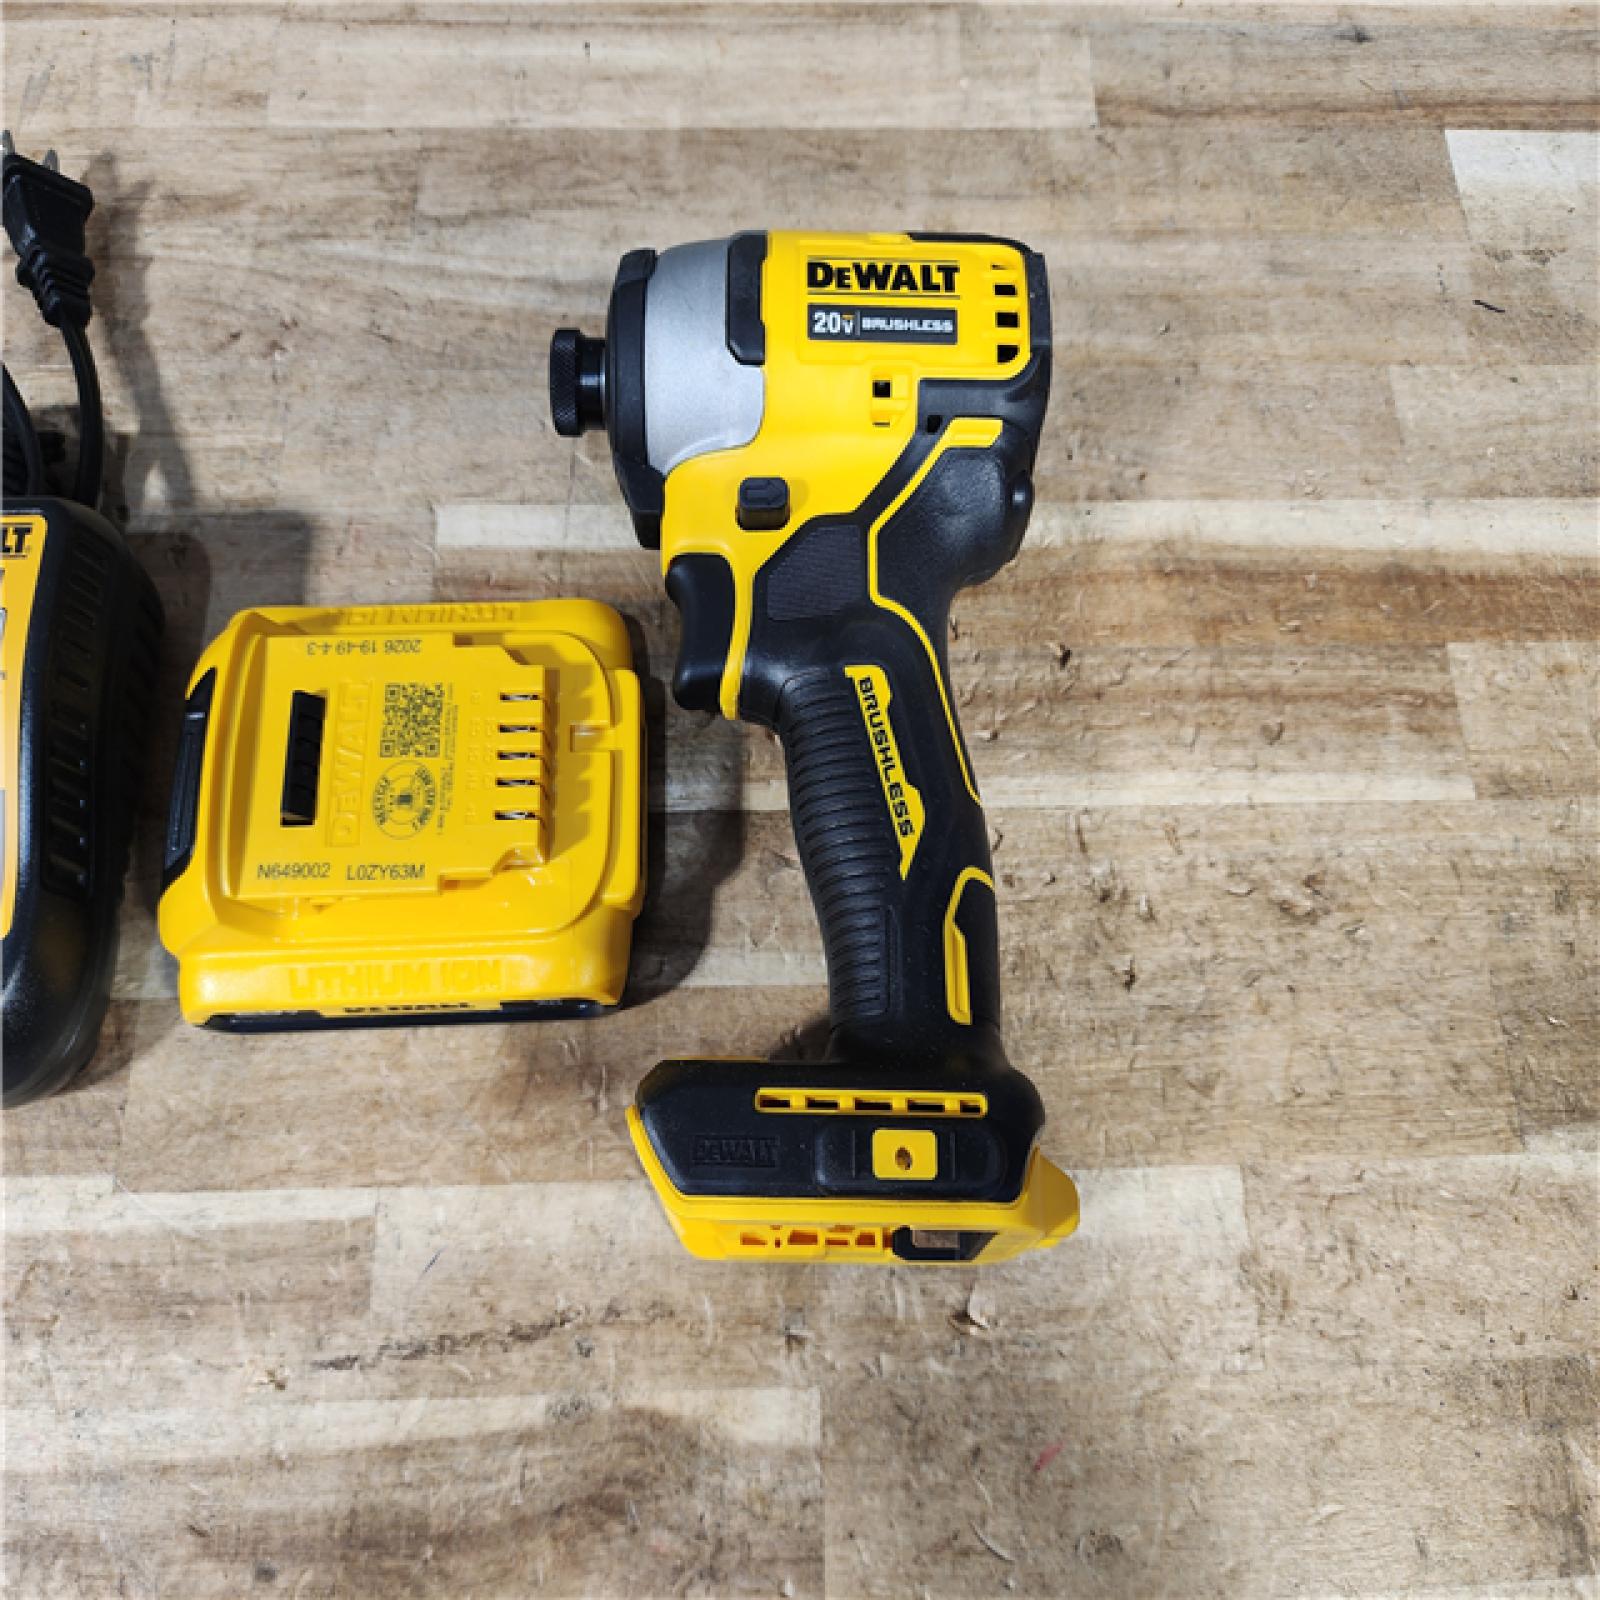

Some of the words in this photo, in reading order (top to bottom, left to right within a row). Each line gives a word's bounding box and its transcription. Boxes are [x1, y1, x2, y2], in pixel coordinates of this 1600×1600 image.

[861, 316, 954, 334] BRUSHLESS
[858, 677, 916, 838] BRUSHLESS
[289, 961, 430, 999] LITHIUM
[440, 959, 502, 993] ION
